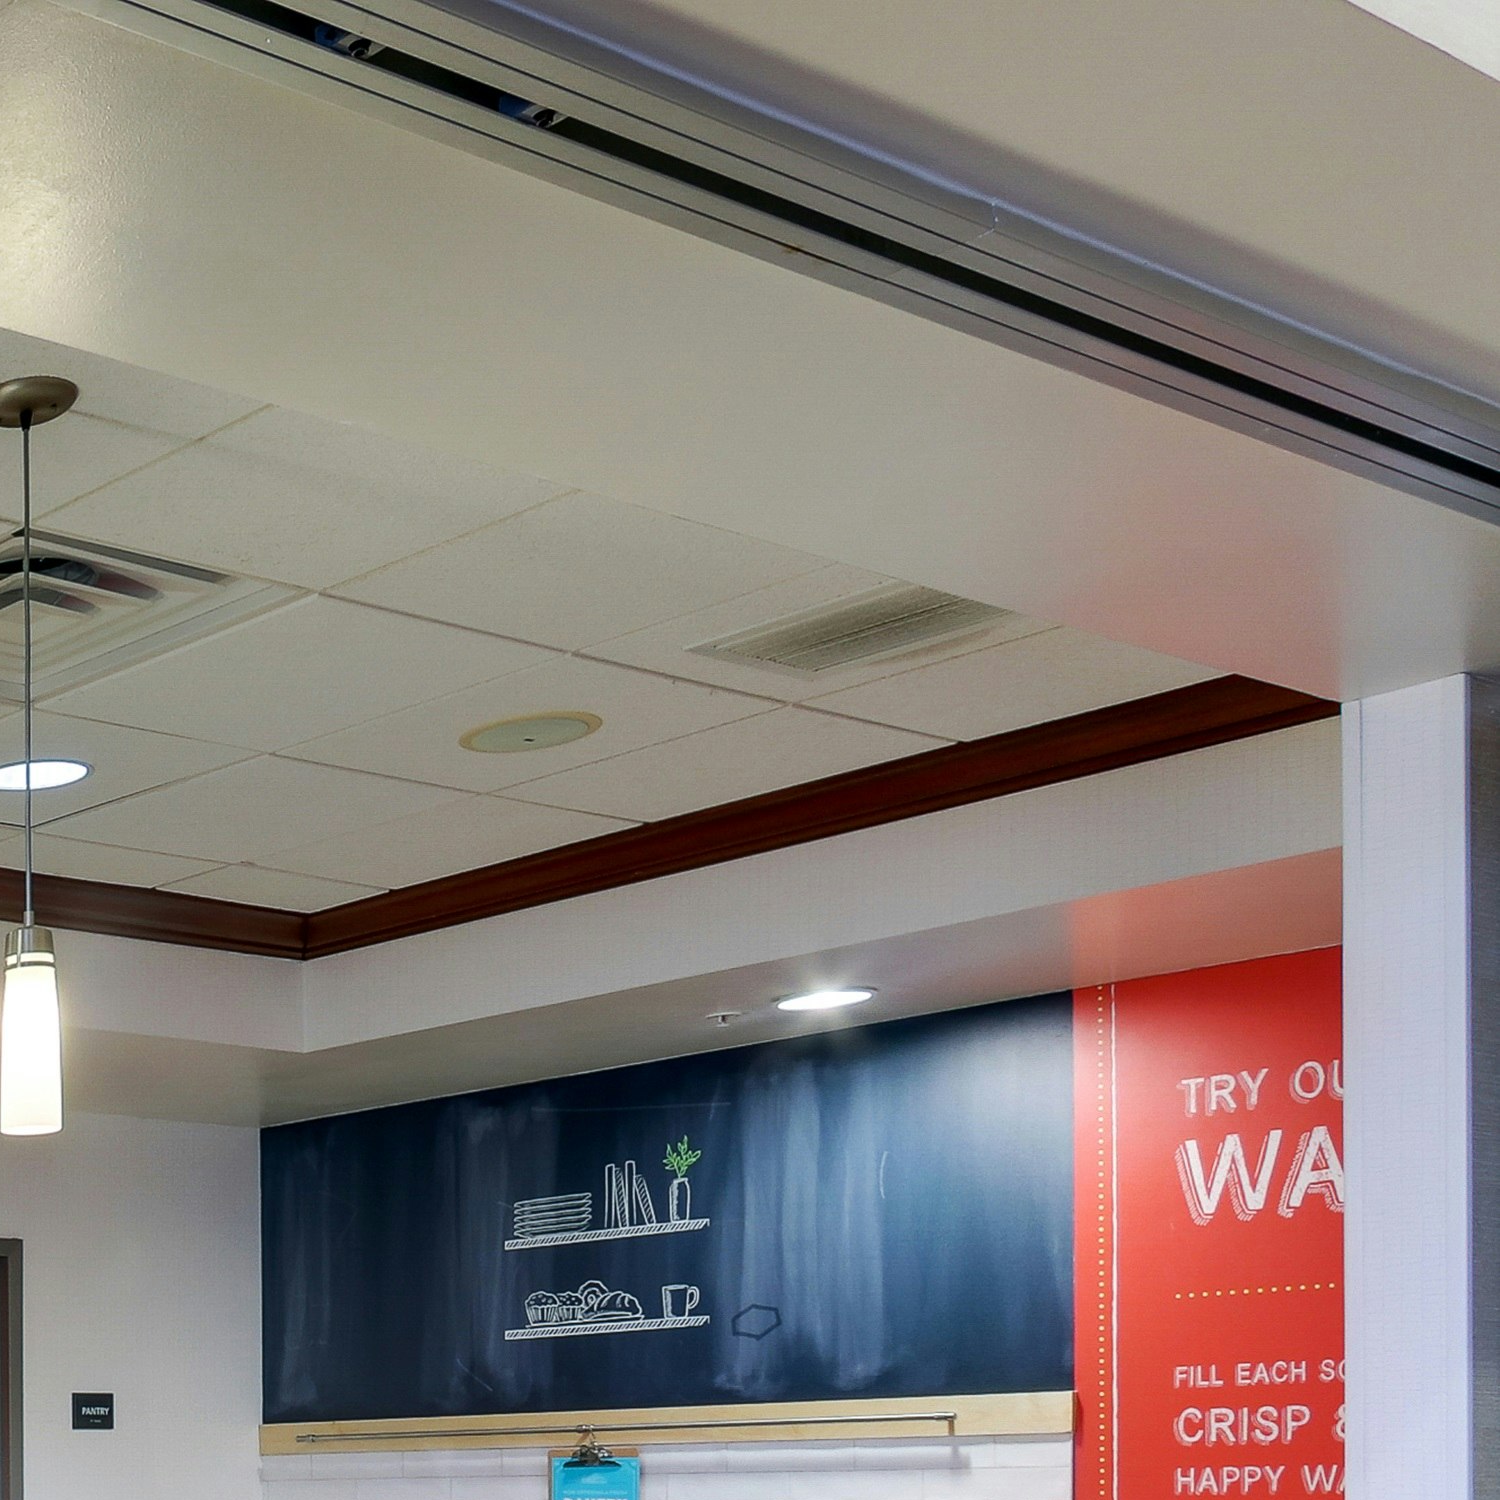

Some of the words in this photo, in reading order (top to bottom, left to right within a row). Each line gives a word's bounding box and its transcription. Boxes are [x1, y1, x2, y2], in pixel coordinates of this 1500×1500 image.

[1176, 1068, 1269, 1117] TRY
[1174, 1364, 1224, 1389] FILL
[1235, 1360, 1307, 1386] EACH
[81, 1406, 110, 1416] PANTRY
[1173, 1404, 1311, 1447] CRISP
[1174, 1465, 1286, 1496] HAPPY
